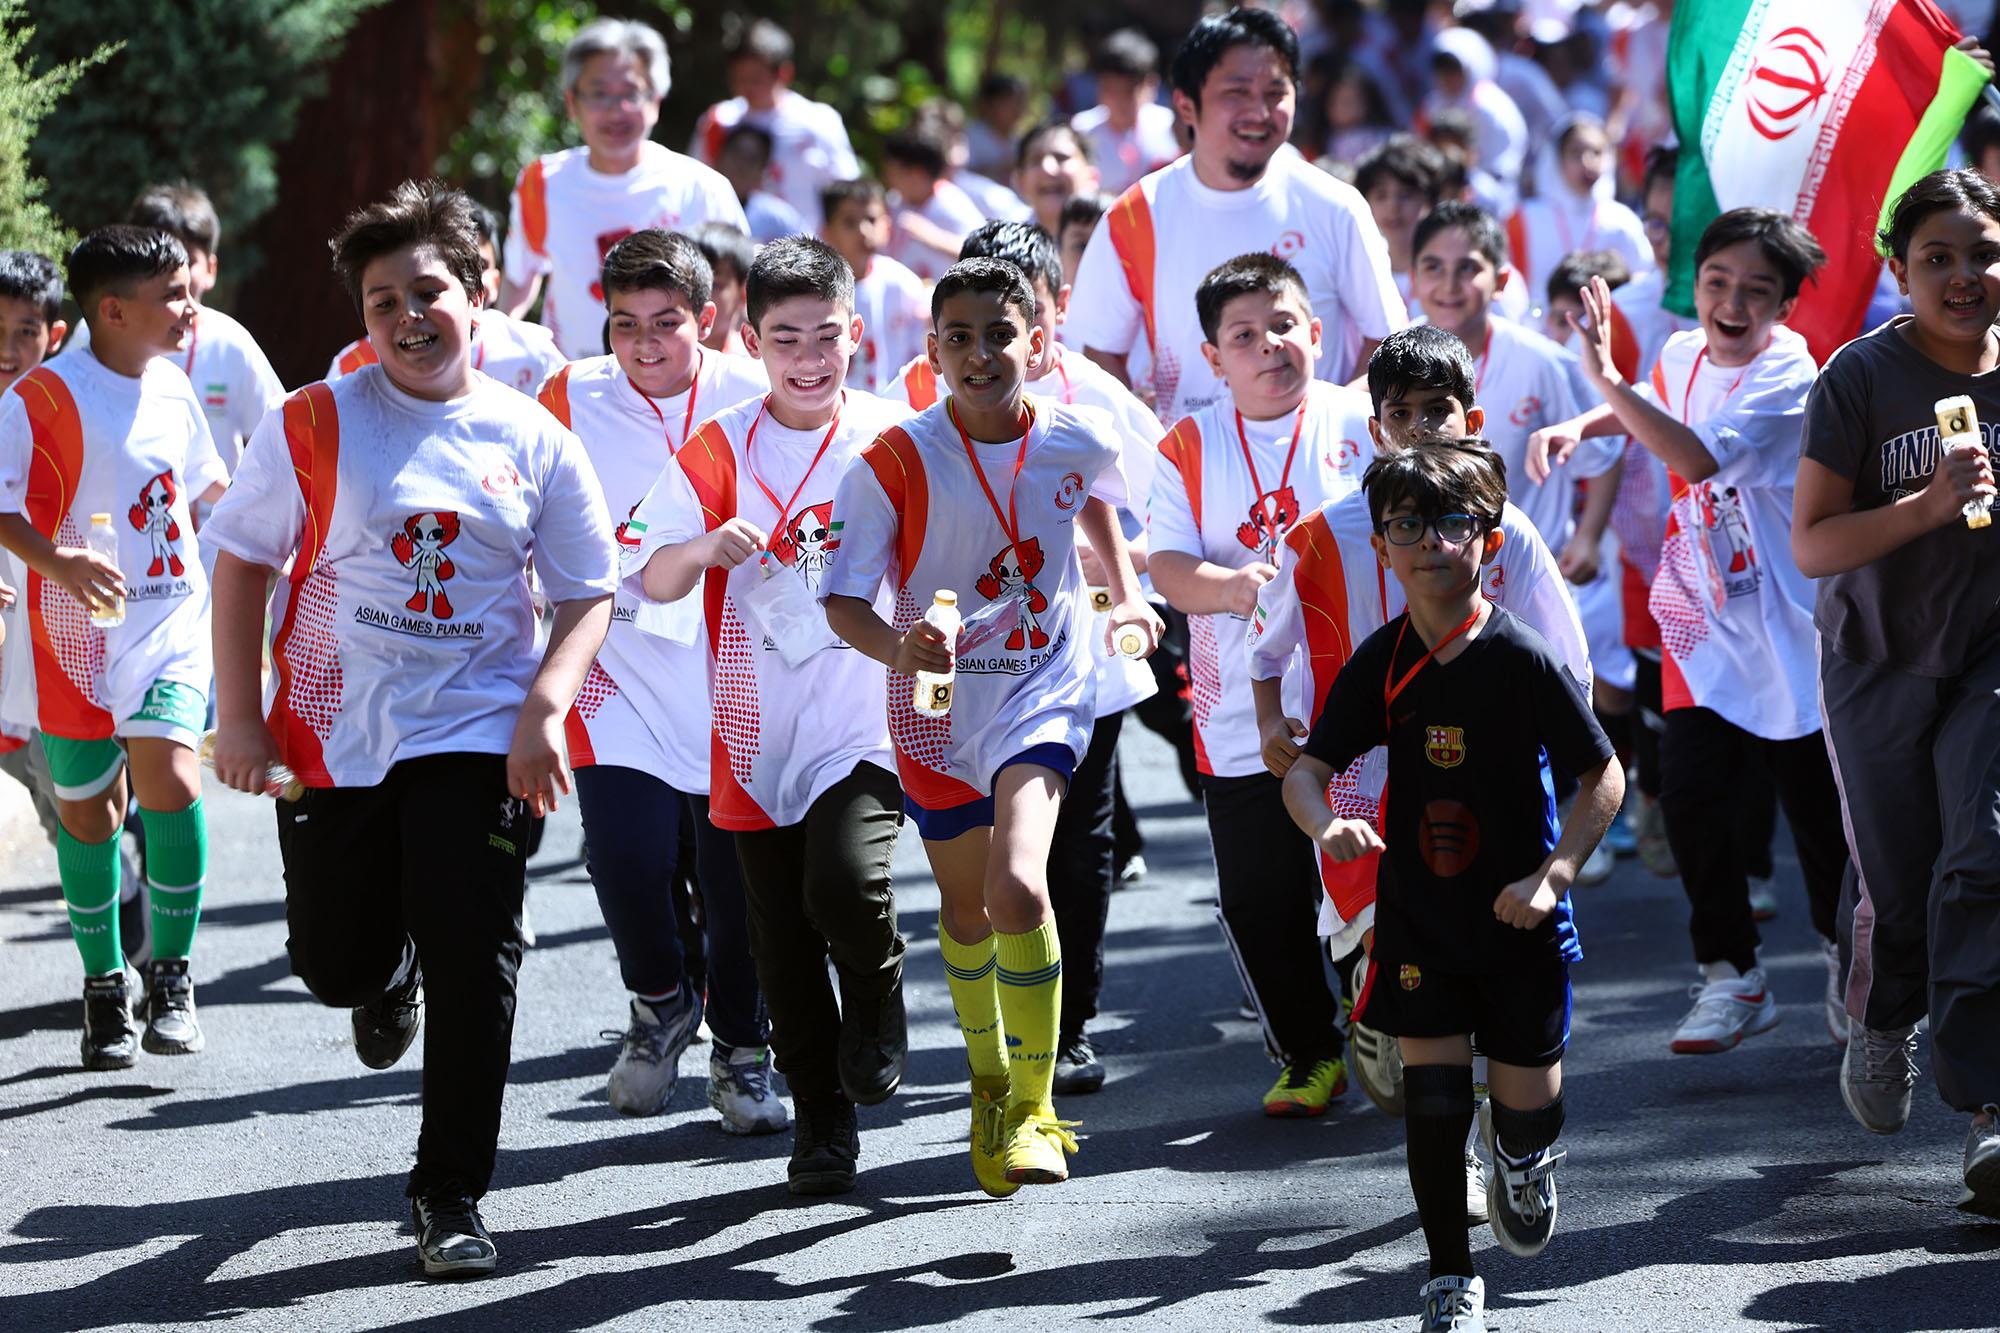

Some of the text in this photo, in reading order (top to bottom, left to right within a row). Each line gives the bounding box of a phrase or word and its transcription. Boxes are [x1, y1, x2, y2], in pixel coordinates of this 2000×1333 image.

[354, 605, 485, 635] ASIAN GAMES FUN RUN
[956, 658, 986, 670] SIAN
[988, 658, 1027, 672] GAMES
